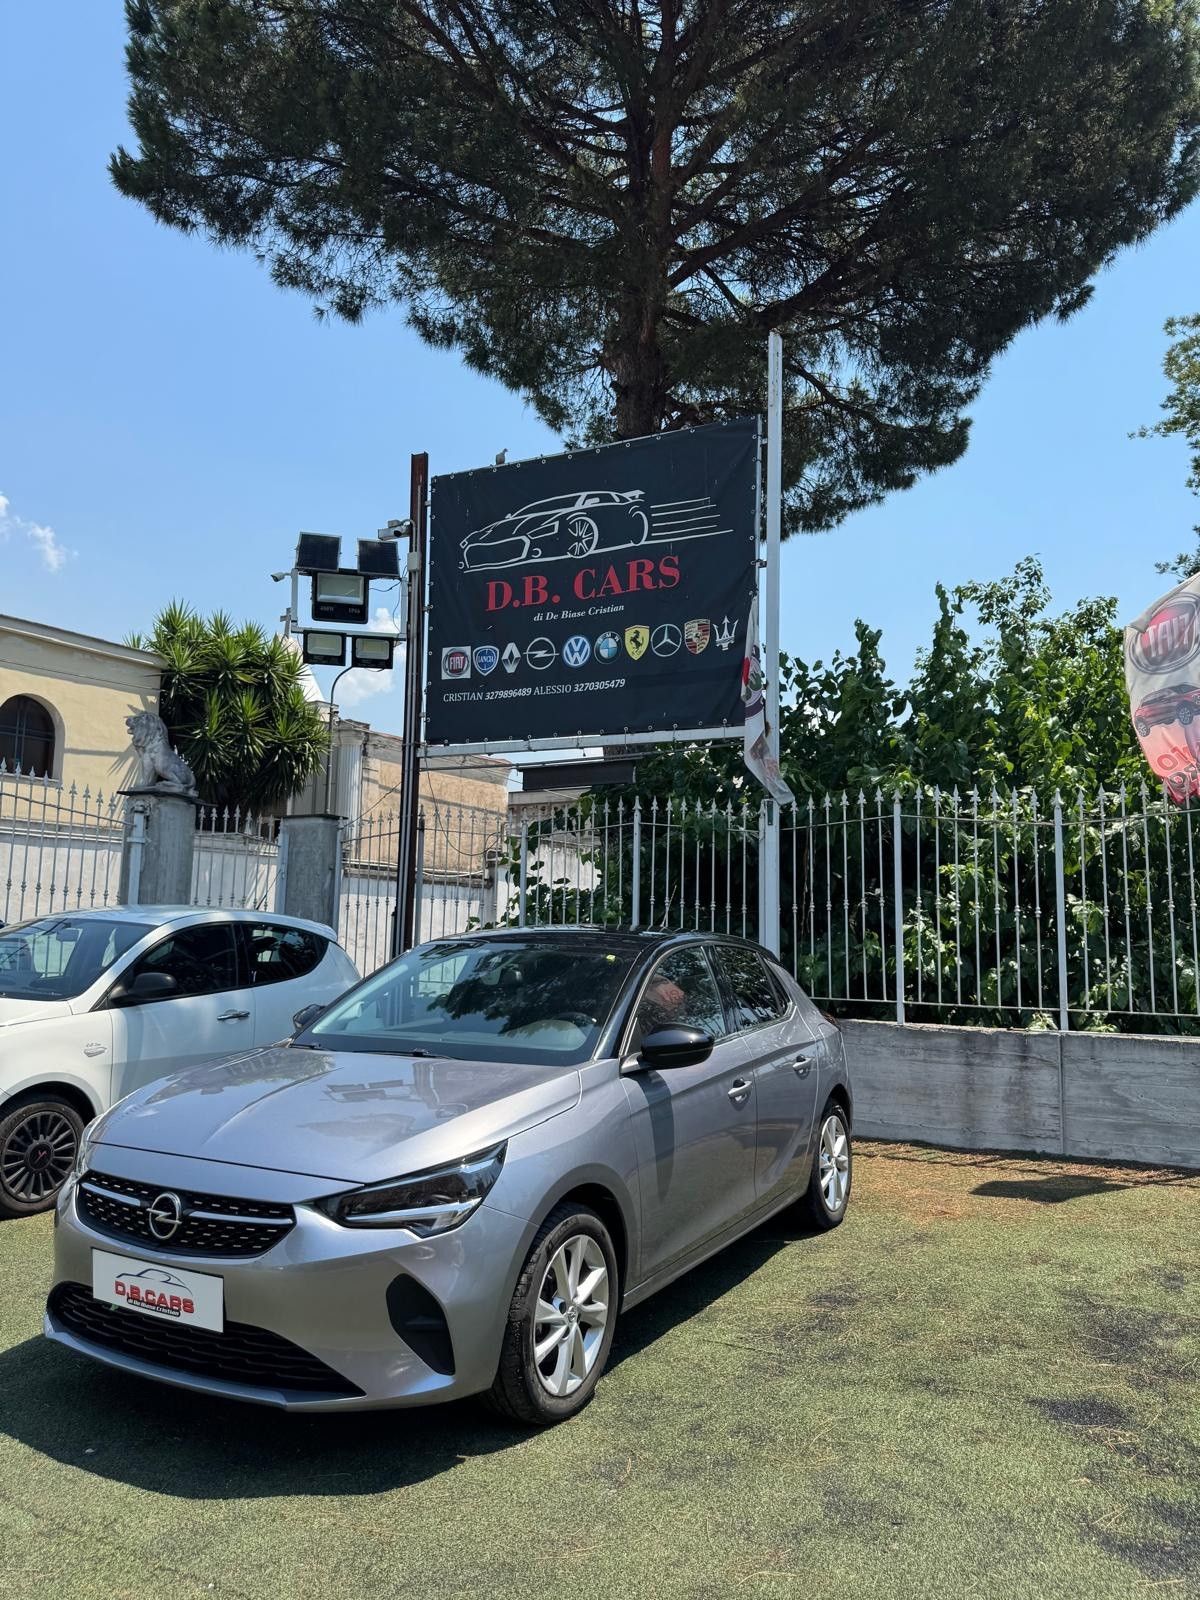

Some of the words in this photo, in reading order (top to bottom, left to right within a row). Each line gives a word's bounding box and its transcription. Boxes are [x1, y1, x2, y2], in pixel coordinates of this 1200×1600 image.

[486, 575, 561, 612] D.B.
[573, 555, 681, 601] CARS
[533, 612, 543, 622] di
[545, 610, 559, 622] De
[561, 608, 586, 620] Biase
[588, 603, 625, 617] Cristian
[449, 656, 465, 670] FIAT
[443, 691, 483, 702] CRISTIAN
[485, 687, 532, 700] 3279896489
[533, 684, 572, 696] ALESSIO
[573, 678, 626, 693] 3270305479
